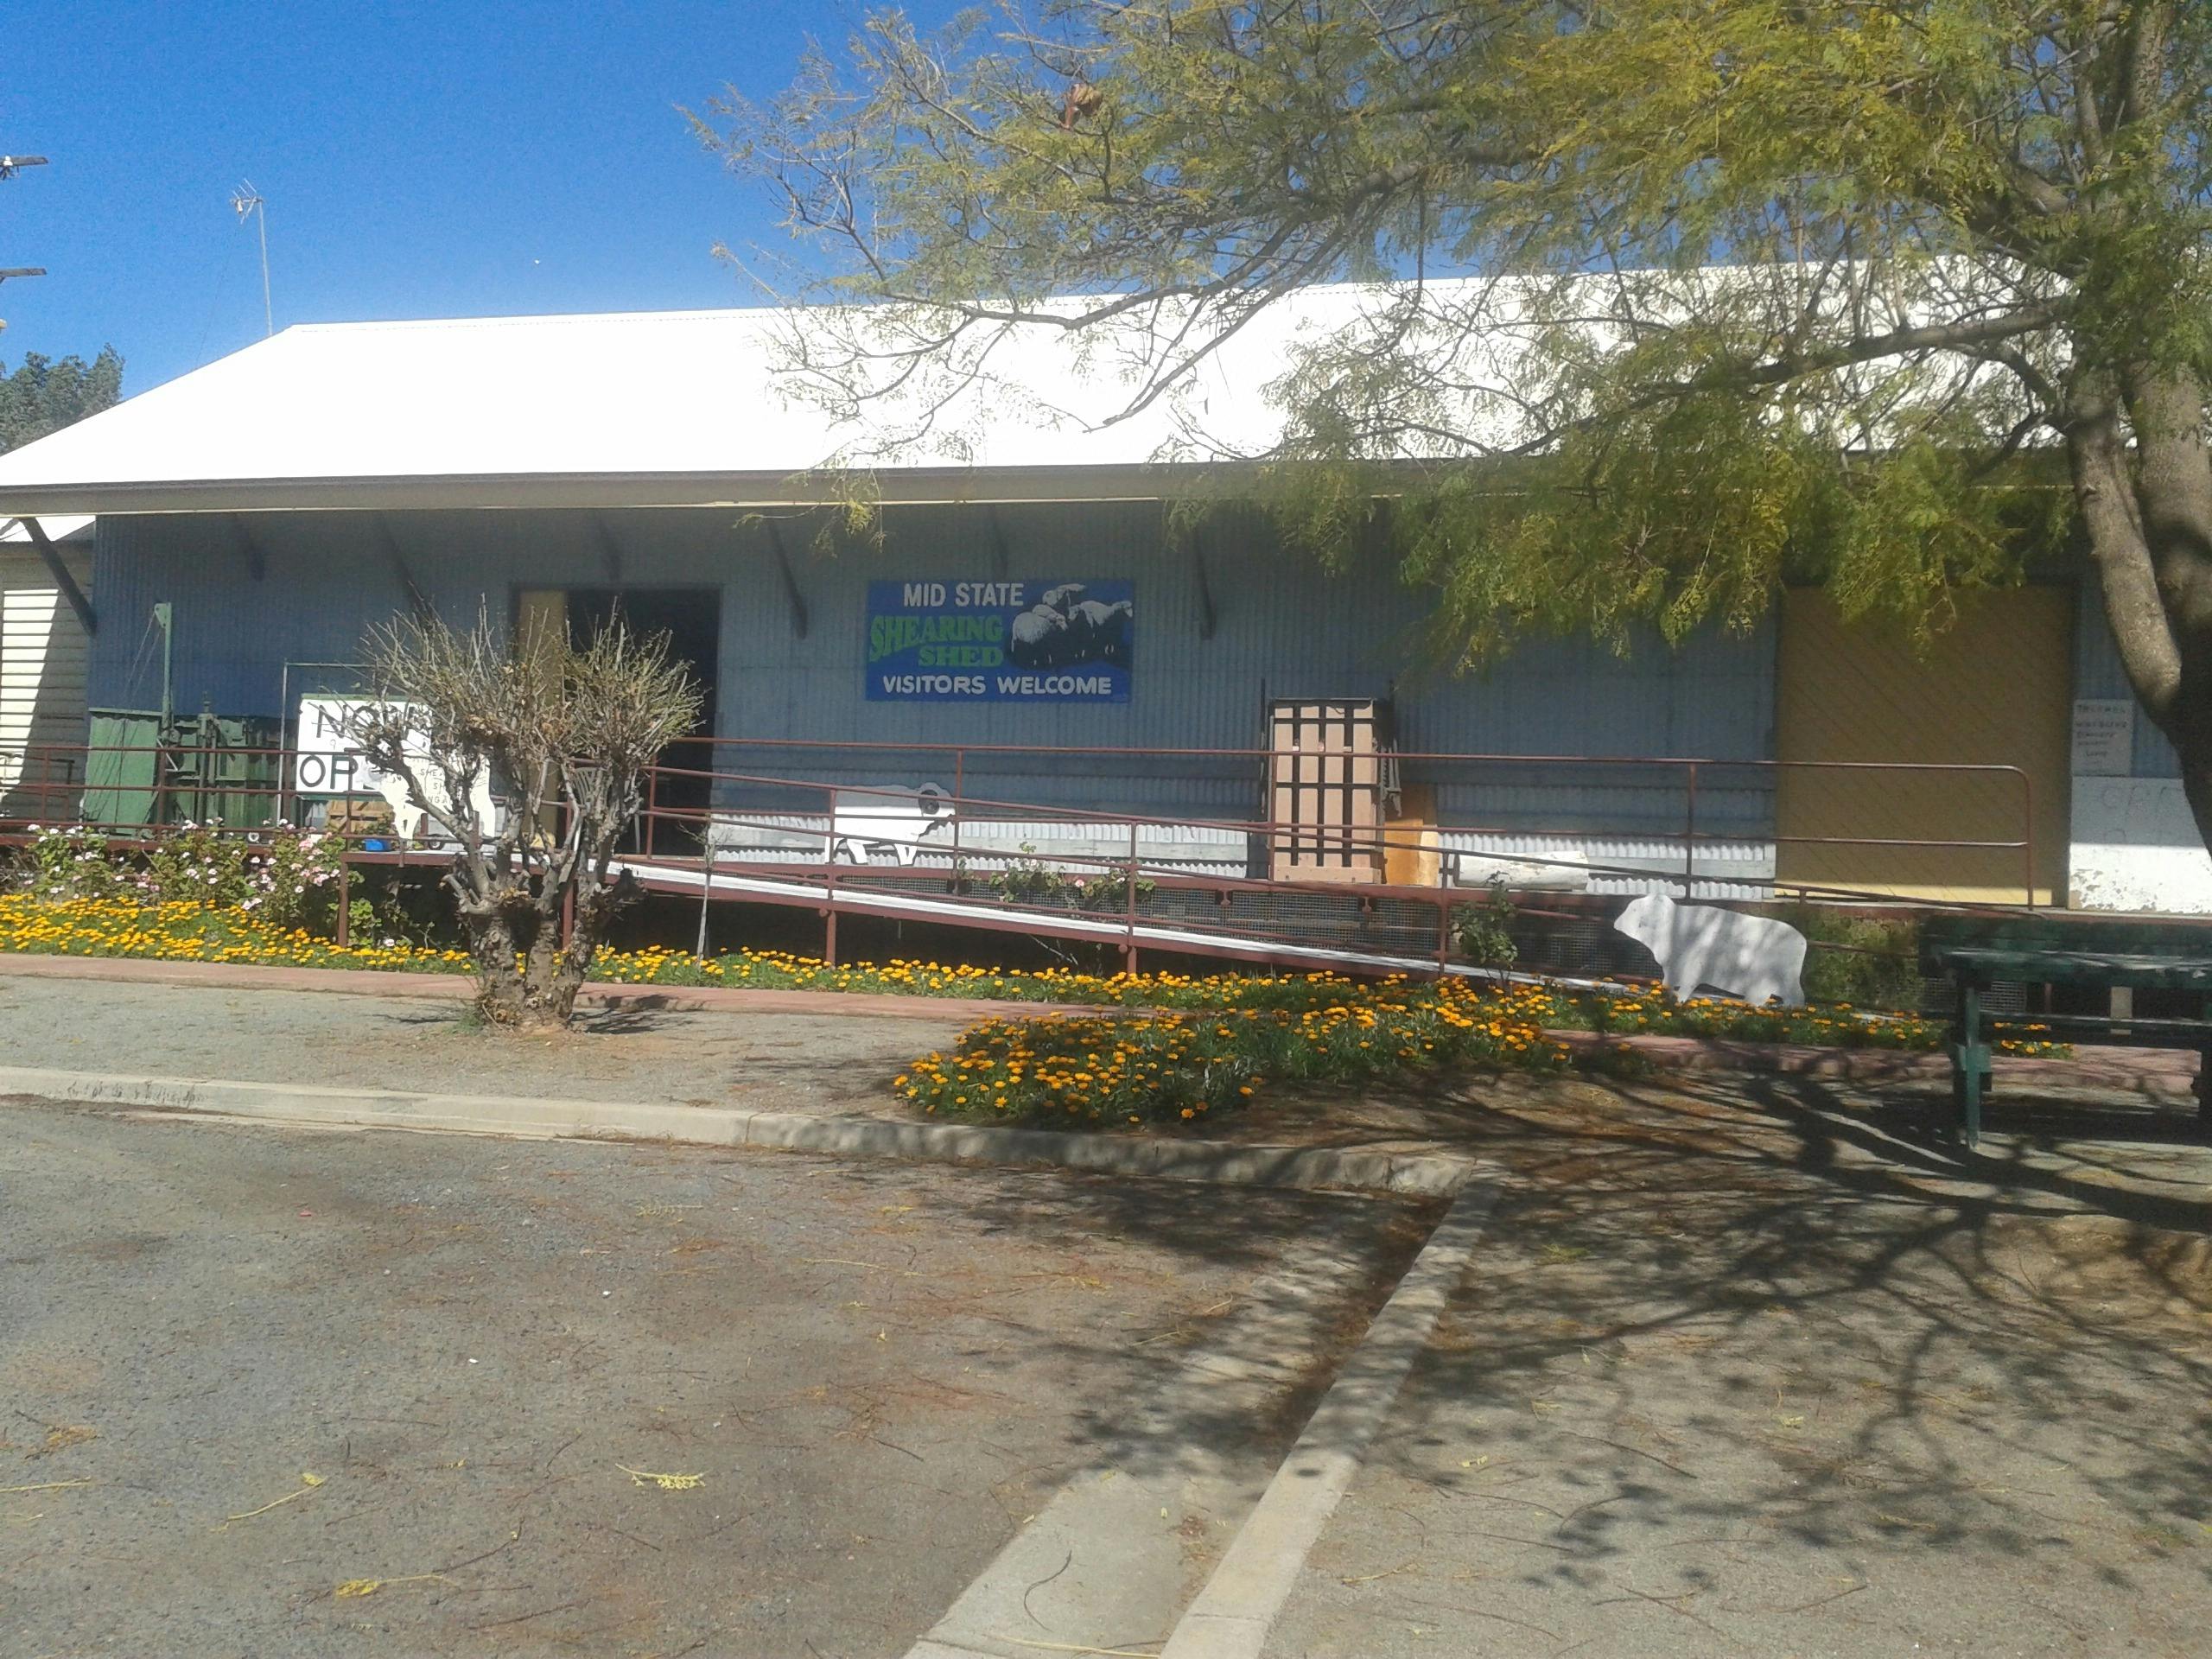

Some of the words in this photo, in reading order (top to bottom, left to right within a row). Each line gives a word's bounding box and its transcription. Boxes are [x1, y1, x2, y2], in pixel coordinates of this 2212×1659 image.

[904, 583, 947, 607] MID
[955, 582, 1023, 607] STATE
[869, 614, 1003, 663] SHEARING
[918, 646, 1004, 667] SHED
[883, 675, 986, 695] VISITORS
[997, 676, 1111, 695] WELCOME
